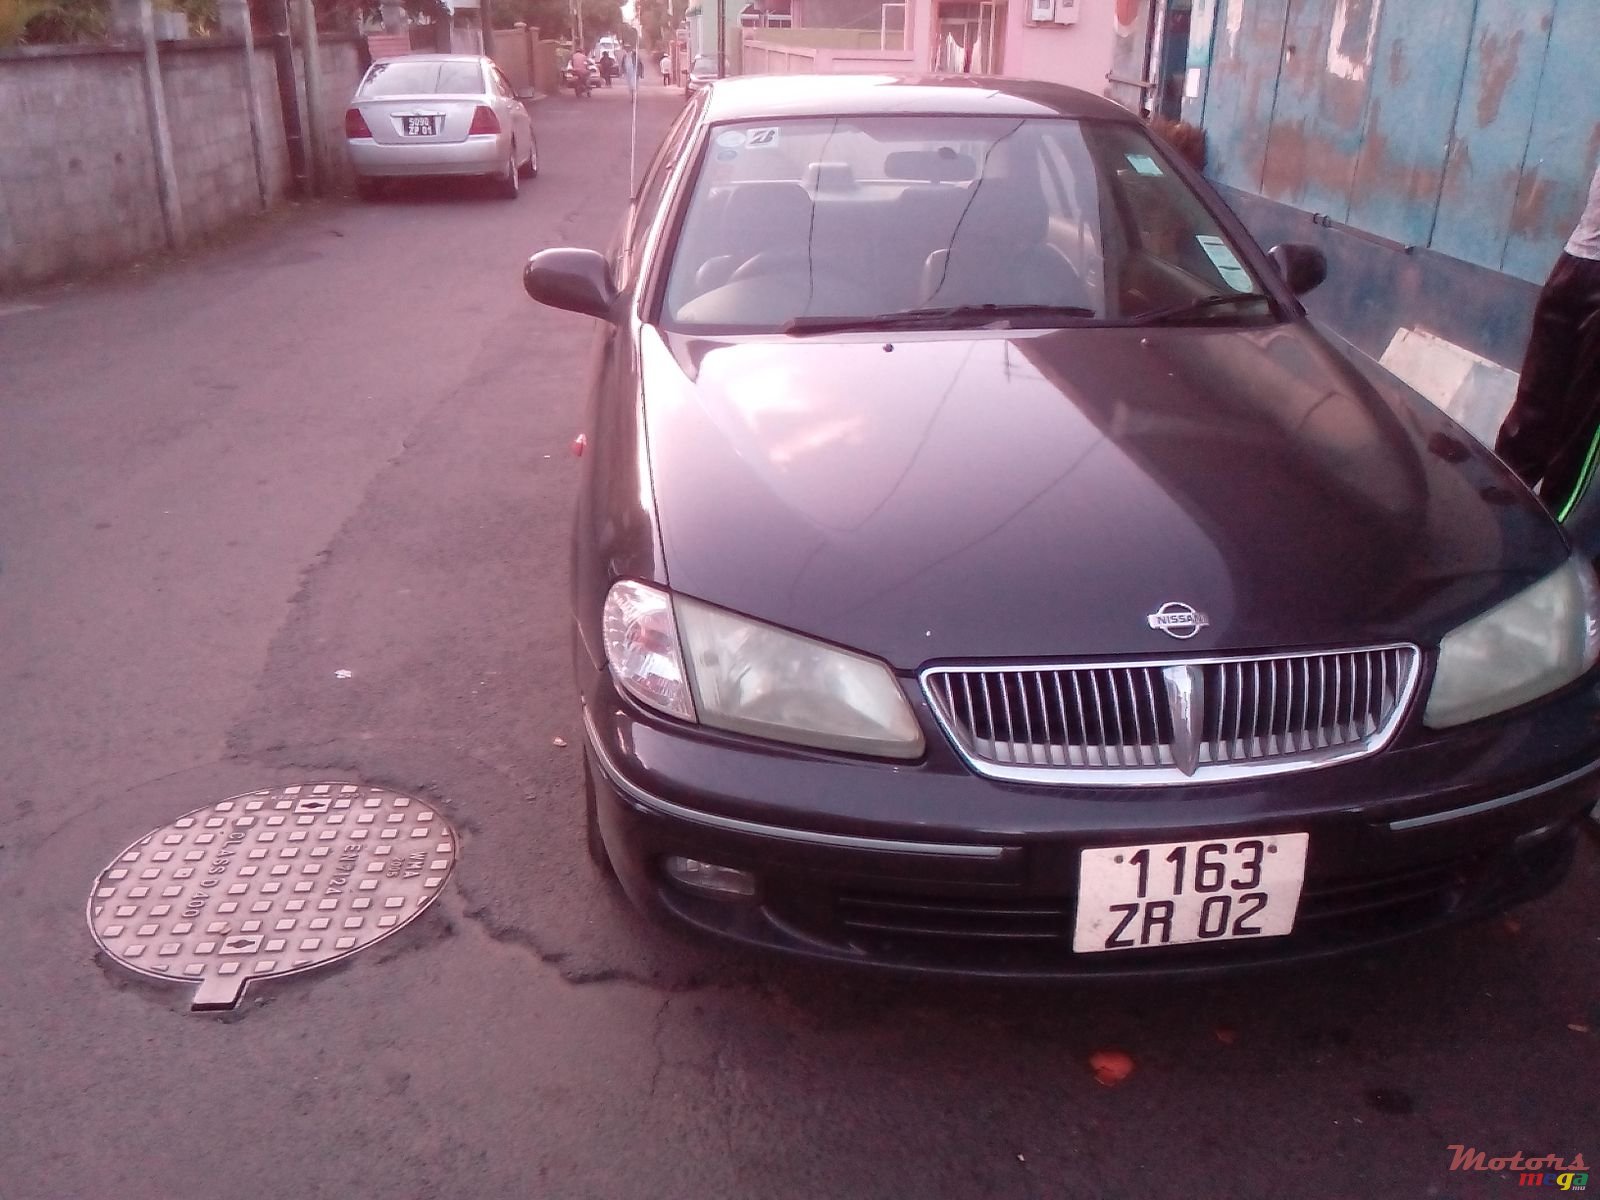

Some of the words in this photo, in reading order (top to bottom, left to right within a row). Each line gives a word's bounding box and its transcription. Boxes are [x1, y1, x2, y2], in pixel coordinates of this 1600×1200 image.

[208, 832, 246, 875] CLASS
[403, 851, 428, 879] WMA
[1129, 840, 1264, 898] 1163
[200, 879, 220, 888] D
[181, 891, 209, 918] 400
[1105, 900, 1174, 949] ZR
[1198, 892, 1268, 939] 02
